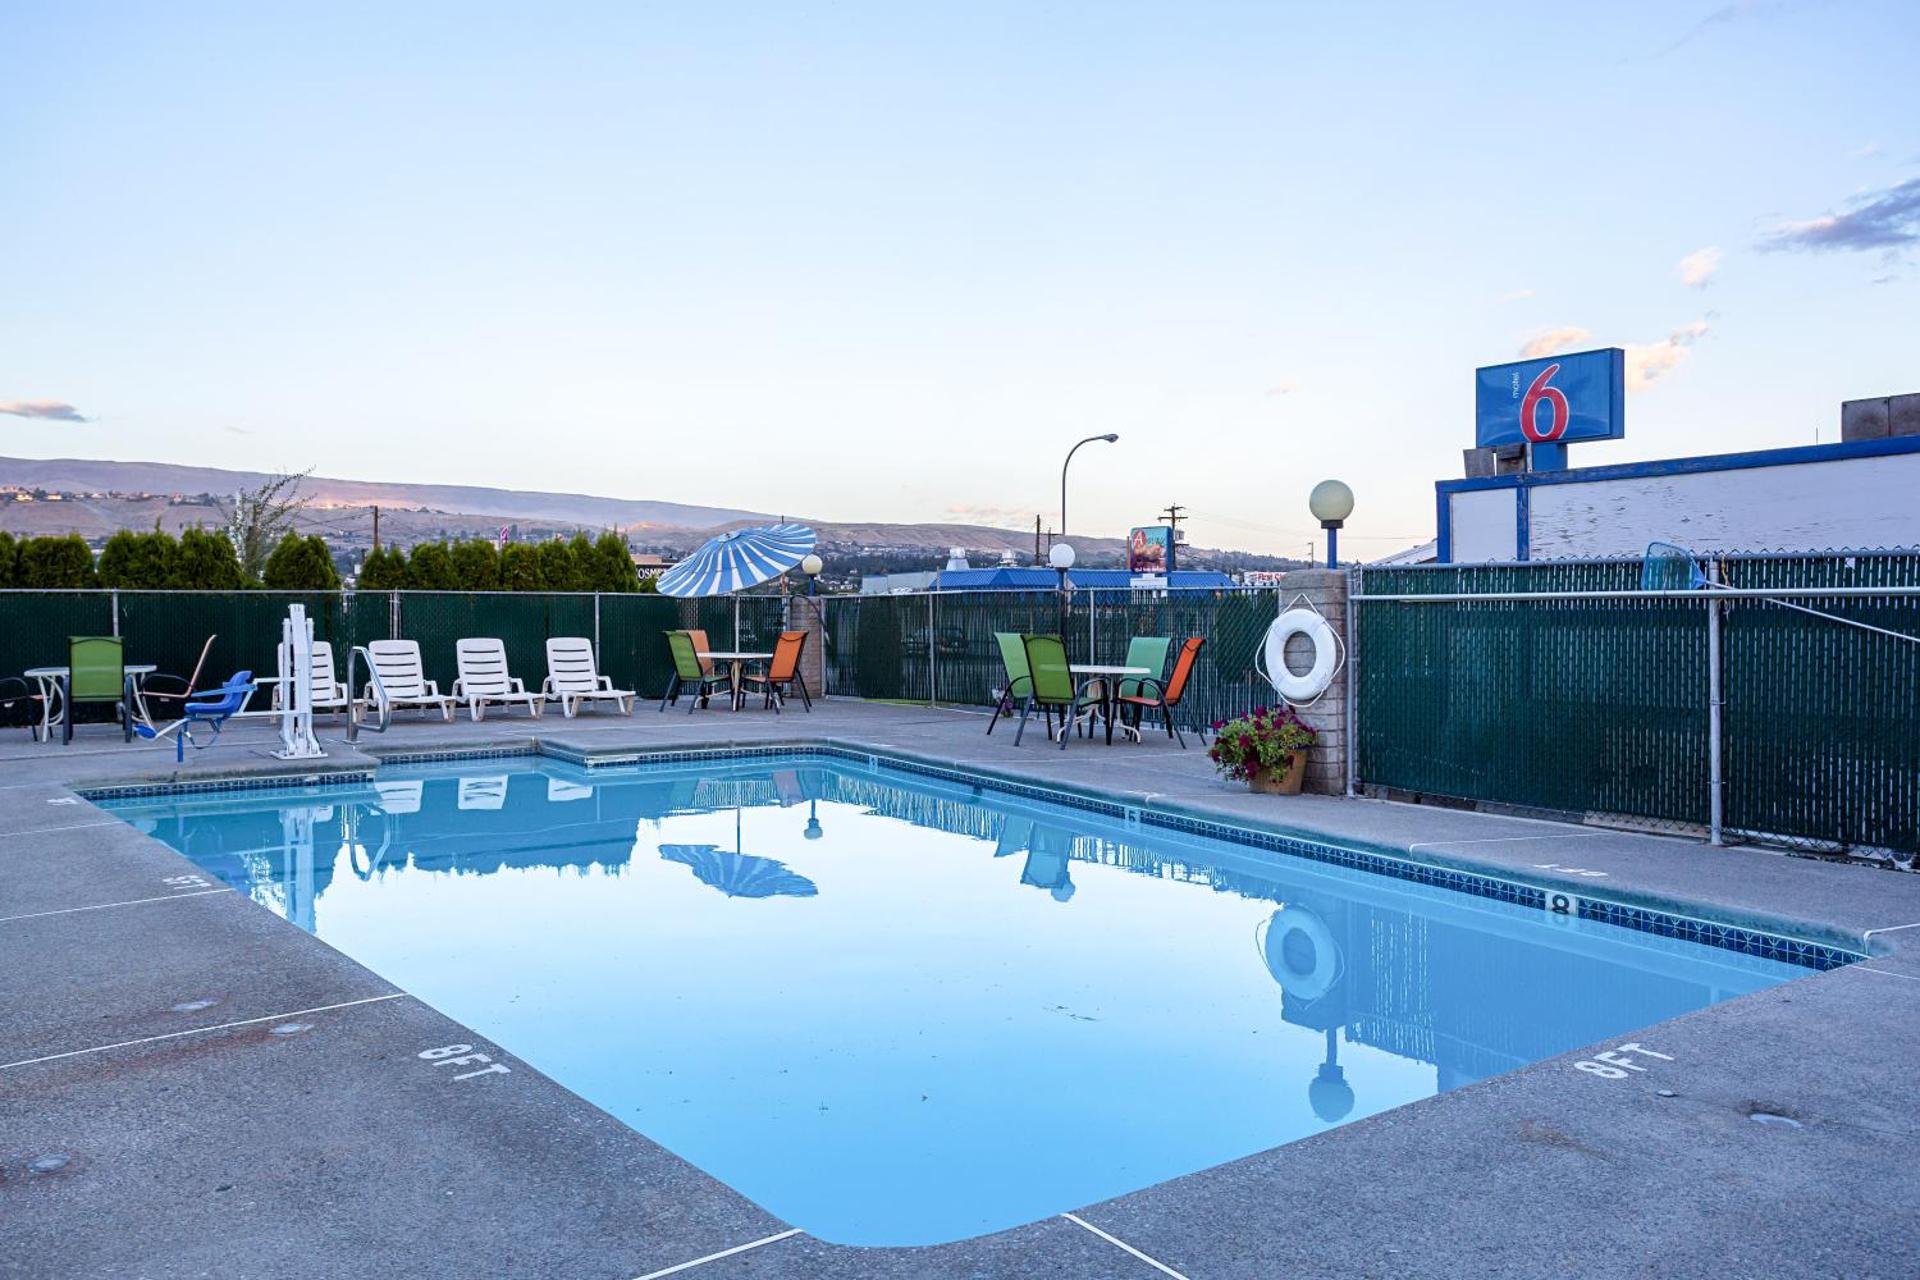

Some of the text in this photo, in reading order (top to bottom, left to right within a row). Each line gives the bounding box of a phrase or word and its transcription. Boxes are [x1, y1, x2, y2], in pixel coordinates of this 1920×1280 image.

[1512, 363, 1570, 443] motel 6
[418, 1044, 512, 1081] 8FT
[1574, 1043, 1675, 1079] 8FT
